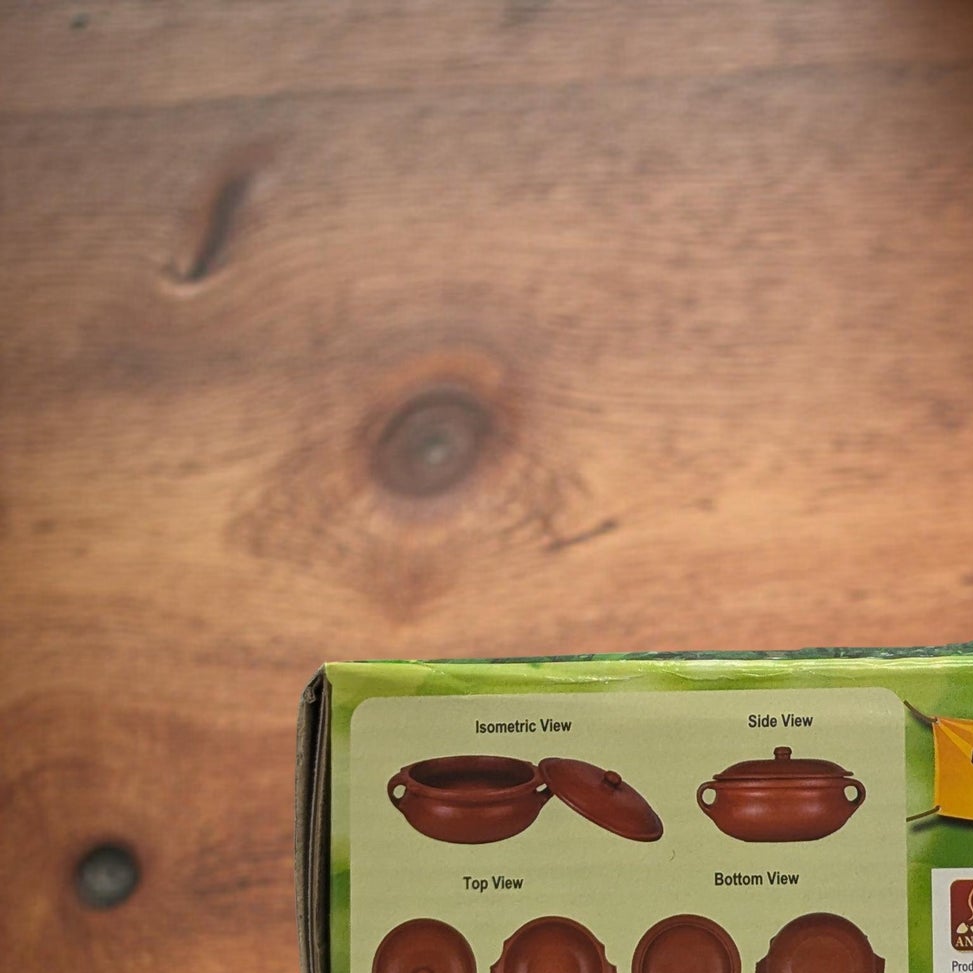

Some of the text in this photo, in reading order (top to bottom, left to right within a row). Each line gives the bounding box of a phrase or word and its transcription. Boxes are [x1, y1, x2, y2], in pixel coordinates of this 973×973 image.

[475, 718, 572, 734] Isometric View
[748, 713, 814, 728] Side View
[463, 876, 524, 892] Top View
[714, 872, 800, 886] Bottom View
